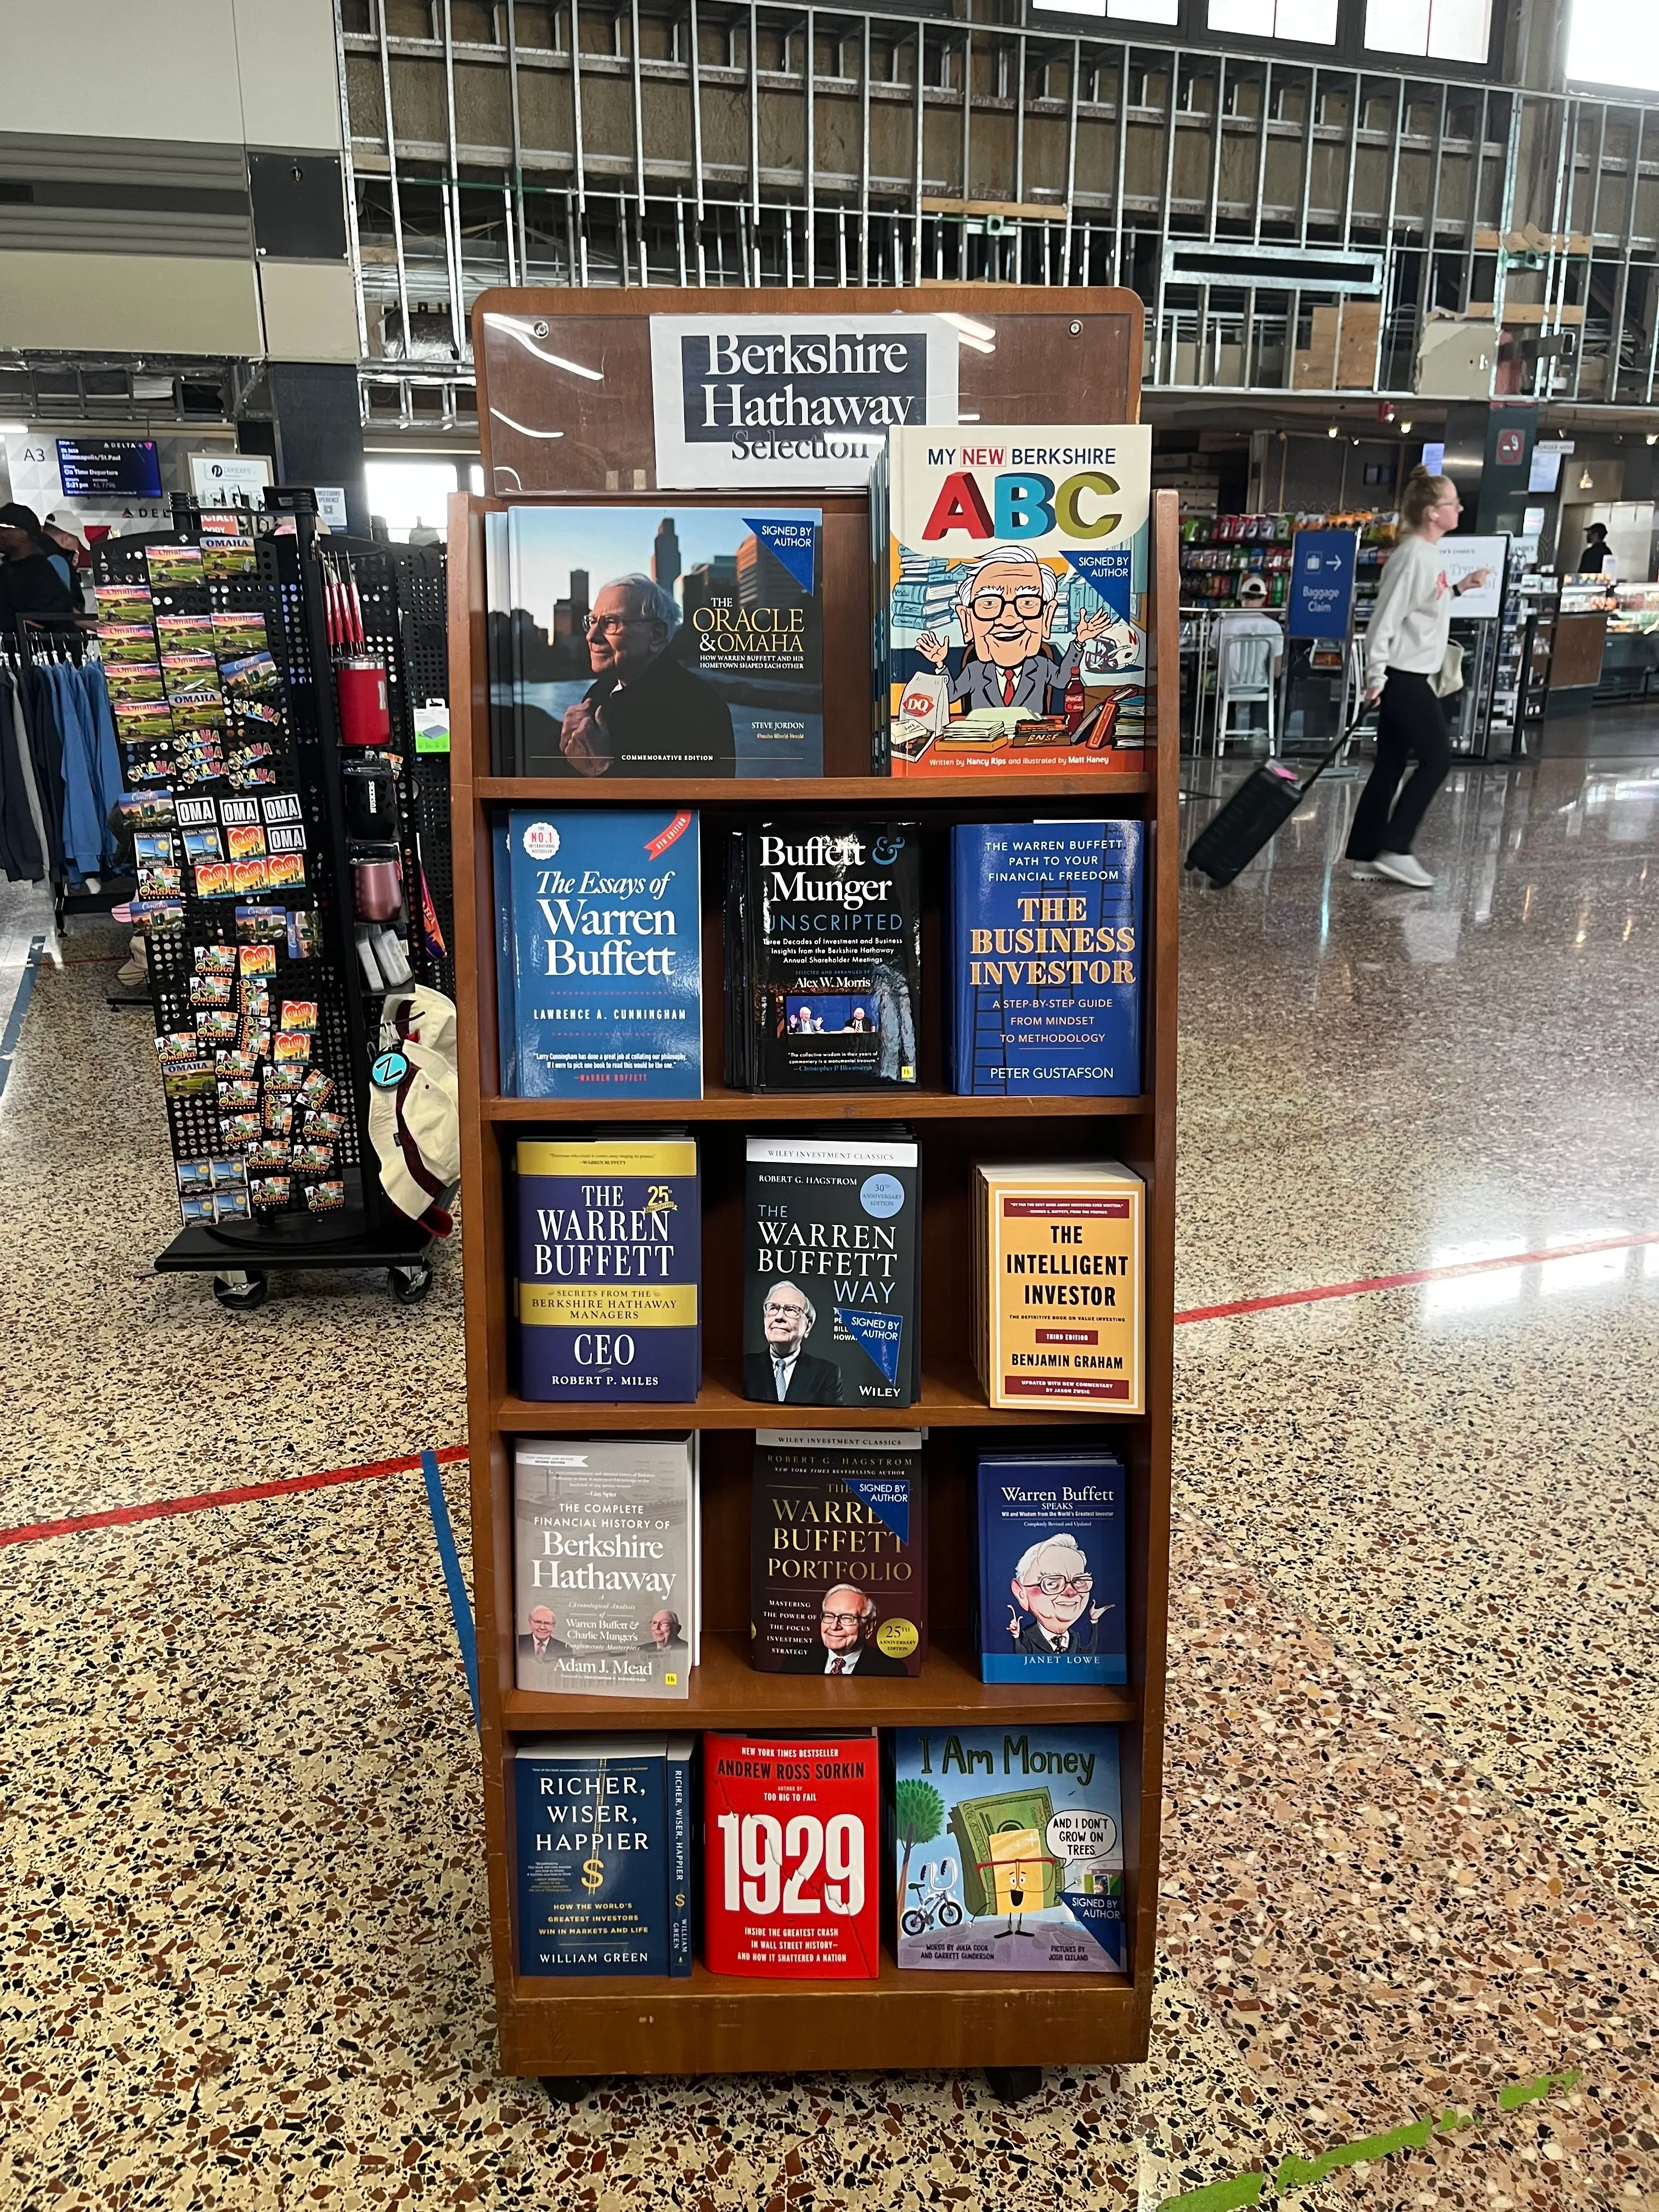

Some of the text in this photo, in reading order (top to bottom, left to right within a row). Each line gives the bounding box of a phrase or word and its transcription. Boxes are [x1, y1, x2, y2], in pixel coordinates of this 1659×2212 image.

[705, 333, 909, 375] Berkshire
[701, 383, 913, 427] Hathaway
[731, 428, 870, 460] Selection
[24, 448, 45, 461] A3
[928, 448, 1116, 465] MY NEW BERKSHIRE
[922, 472, 1122, 540] ABC
[761, 526, 812, 537] SIGNED BY
[206, 539, 249, 547] OMAHA
[774, 538, 811, 547] AUTHOR
[1079, 557, 1128, 567] SIGNED BY
[1091, 568, 1128, 577] AUTHOR
[1303, 586, 1339, 600] Baggage
[710, 597, 732, 607] THE
[1308, 601, 1331, 612] Claim
[693, 607, 804, 633] ORACLE
[174, 693, 216, 703] OMAHA
[906, 697, 929, 711] DQ
[956, 759, 964, 768] by
[967, 758, 989, 767] Nancy
[991, 757, 1006, 766] Rips
[1023, 757, 1056, 765] illustrated
[1058, 757, 1066, 766] by
[1087, 755, 1109, 765] Haney
[180, 802, 212, 821] OMA
[224, 803, 256, 821] OMA
[266, 798, 297, 819] OMA
[667, 817, 687, 840] EDITION
[234, 833, 257, 847] OMAHA
[272, 828, 302, 848] OMA
[985, 840, 1122, 851] THE WARREN BUFFETT
[760, 836, 905, 866] Buffett &
[274, 861, 297, 873] OMAHA
[1009, 856, 1098, 866] PATH TO YOUR
[203, 870, 224, 883] OMAHA
[989, 871, 1119, 882] FINANCIAL FREEDOM
[536, 871, 675, 900] The Essays of
[770, 871, 892, 910] Munger
[536, 899, 677, 935] Warren
[1018, 898, 1087, 922] THE
[764, 914, 902, 930] UNSCRIPTED
[970, 927, 1135, 953] BUSINESS
[544, 940, 676, 976] Buffett
[195, 963, 233, 973] Omaha
[970, 961, 1136, 985] INVESTOR
[795, 977, 871, 988] Alex W. Morris
[190, 993, 228, 1003] Omaha
[533, 1009, 686, 1020] LAWRENCE A. CUNNINGHAM
[197, 1028, 234, 1038] Omaha
[168, 1063, 207, 1073] OMAHA
[215, 1065, 252, 1077] Omaha
[990, 1068, 1114, 1079] PETER GUSTAFSON
[759, 1175, 857, 1186] ROBERT G. HAGSTROM
[582, 1186, 624, 1206] THE
[758, 1204, 788, 1218] THE
[537, 1209, 670, 1242] WARREN
[758, 1221, 896, 1249] WARREN
[1051, 1226, 1082, 1244] THE
[535, 1244, 674, 1276] BUFFETT
[758, 1249, 897, 1278] BUFFETT
[1007, 1254, 1128, 1276] INTELLIGENT
[834, 1280, 895, 1304] WAY
[1024, 1285, 1115, 1306] INVESTOR
[574, 1334, 635, 1365] CEO
[1012, 1353, 1123, 1369] BENJAMIN GRAHAM
[552, 1376, 658, 1385] ROBERT P. MILES
[859, 1385, 901, 1397] WILEY
[1001, 1487, 1114, 1501] Warren Buffett
[542, 1531, 664, 1559] Berkshire
[772, 1527, 902, 1554] BUFFETT
[768, 1558, 912, 1581] PORTFOLIO
[531, 1559, 677, 1600] Hathaway
[554, 1658, 652, 1675] Adam J. Mead
[1024, 1656, 1061, 1665] JANET
[919, 1735, 1096, 1786] I Am Money
[718, 1759, 864, 1780] ANDREW ROSS SORKIN
[540, 1777, 646, 1796] RICHER,
[547, 1805, 637, 1825] WISER,
[1053, 1818, 1108, 1829] AND I DON'T
[536, 1833, 649, 1850] HAPPIER
[1059, 1831, 1103, 1842] GROW ON
[718, 1813, 865, 1916] 1929
[540, 1953, 648, 1963] WILLIAM GREEN
